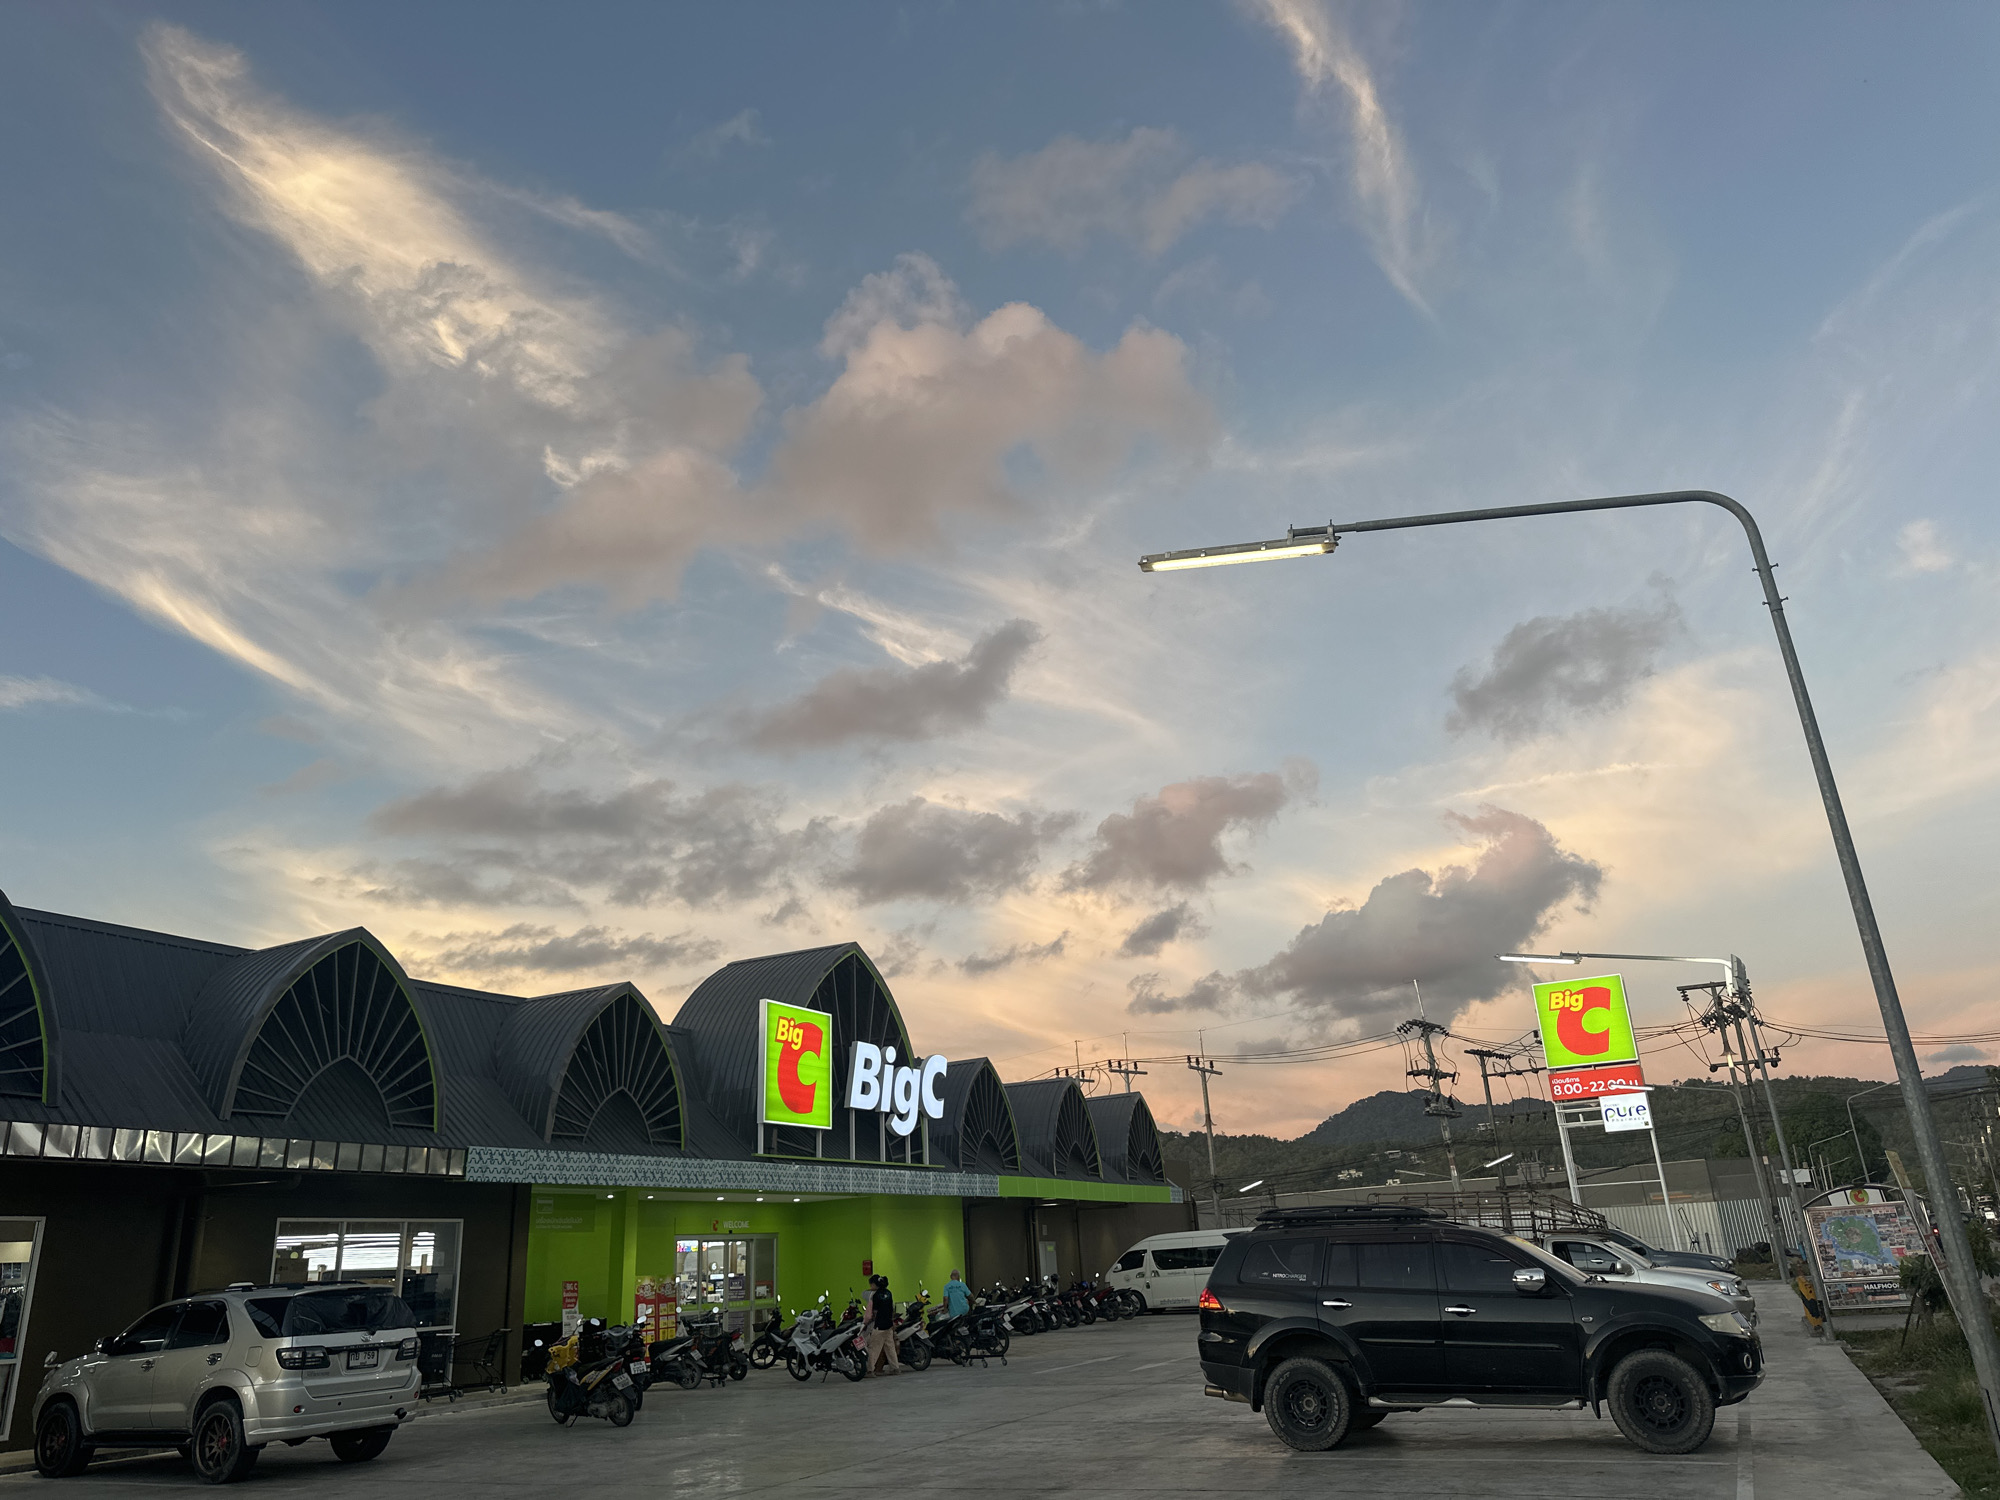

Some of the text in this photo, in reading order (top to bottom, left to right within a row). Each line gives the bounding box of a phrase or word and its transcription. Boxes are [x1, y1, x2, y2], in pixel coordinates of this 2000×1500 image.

[1550, 989, 1584, 1012] Big
[1556, 986, 1611, 1056] C
[776, 1018, 803, 1050] Big
[777, 1022, 823, 1114] C
[1604, 1105, 1647, 1122] pure
[723, 1220, 750, 1229] WELCOME
[363, 1351, 375, 1360] 759
